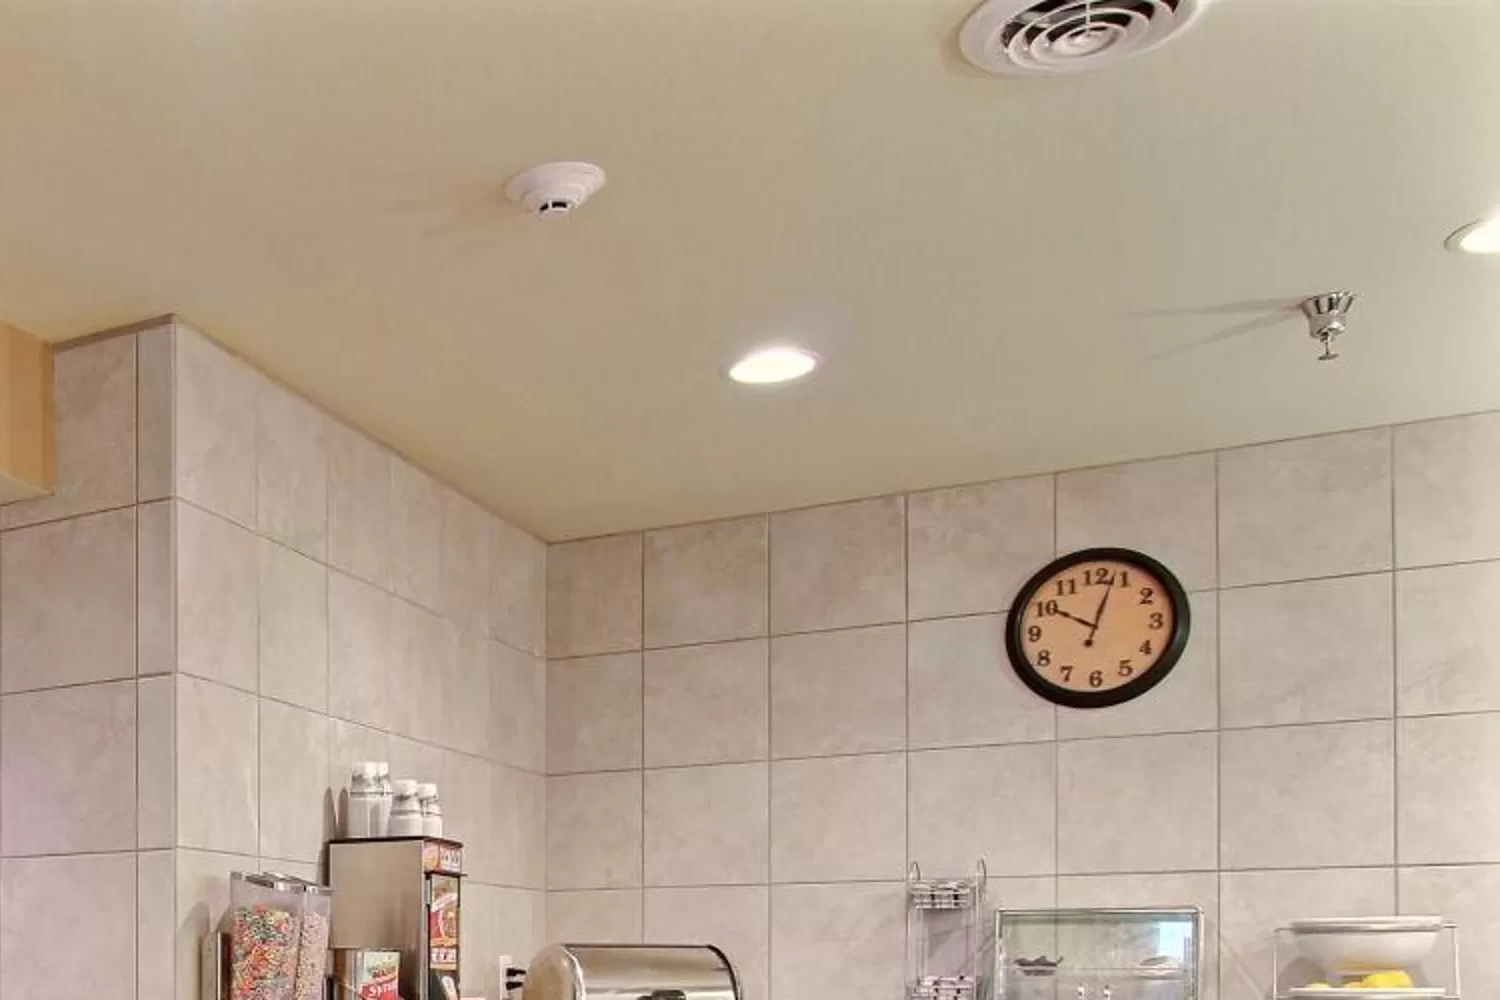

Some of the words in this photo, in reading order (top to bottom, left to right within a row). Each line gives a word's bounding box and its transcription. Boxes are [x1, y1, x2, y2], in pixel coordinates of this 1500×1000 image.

[1083, 568, 1111, 585] 12
[1120, 571, 1130, 587] 1
[1056, 579, 1077, 596] 11
[1139, 588, 1153, 605] 2
[1036, 600, 1058, 617] 10
[1150, 612, 1164, 629] 3
[1028, 626, 1042, 642] 9
[1139, 640, 1153, 655] 4
[1037, 650, 1051, 666] 8
[1060, 666, 1073, 682] 7
[1118, 660, 1133, 676] 5
[1089, 671, 1103, 688] 6
